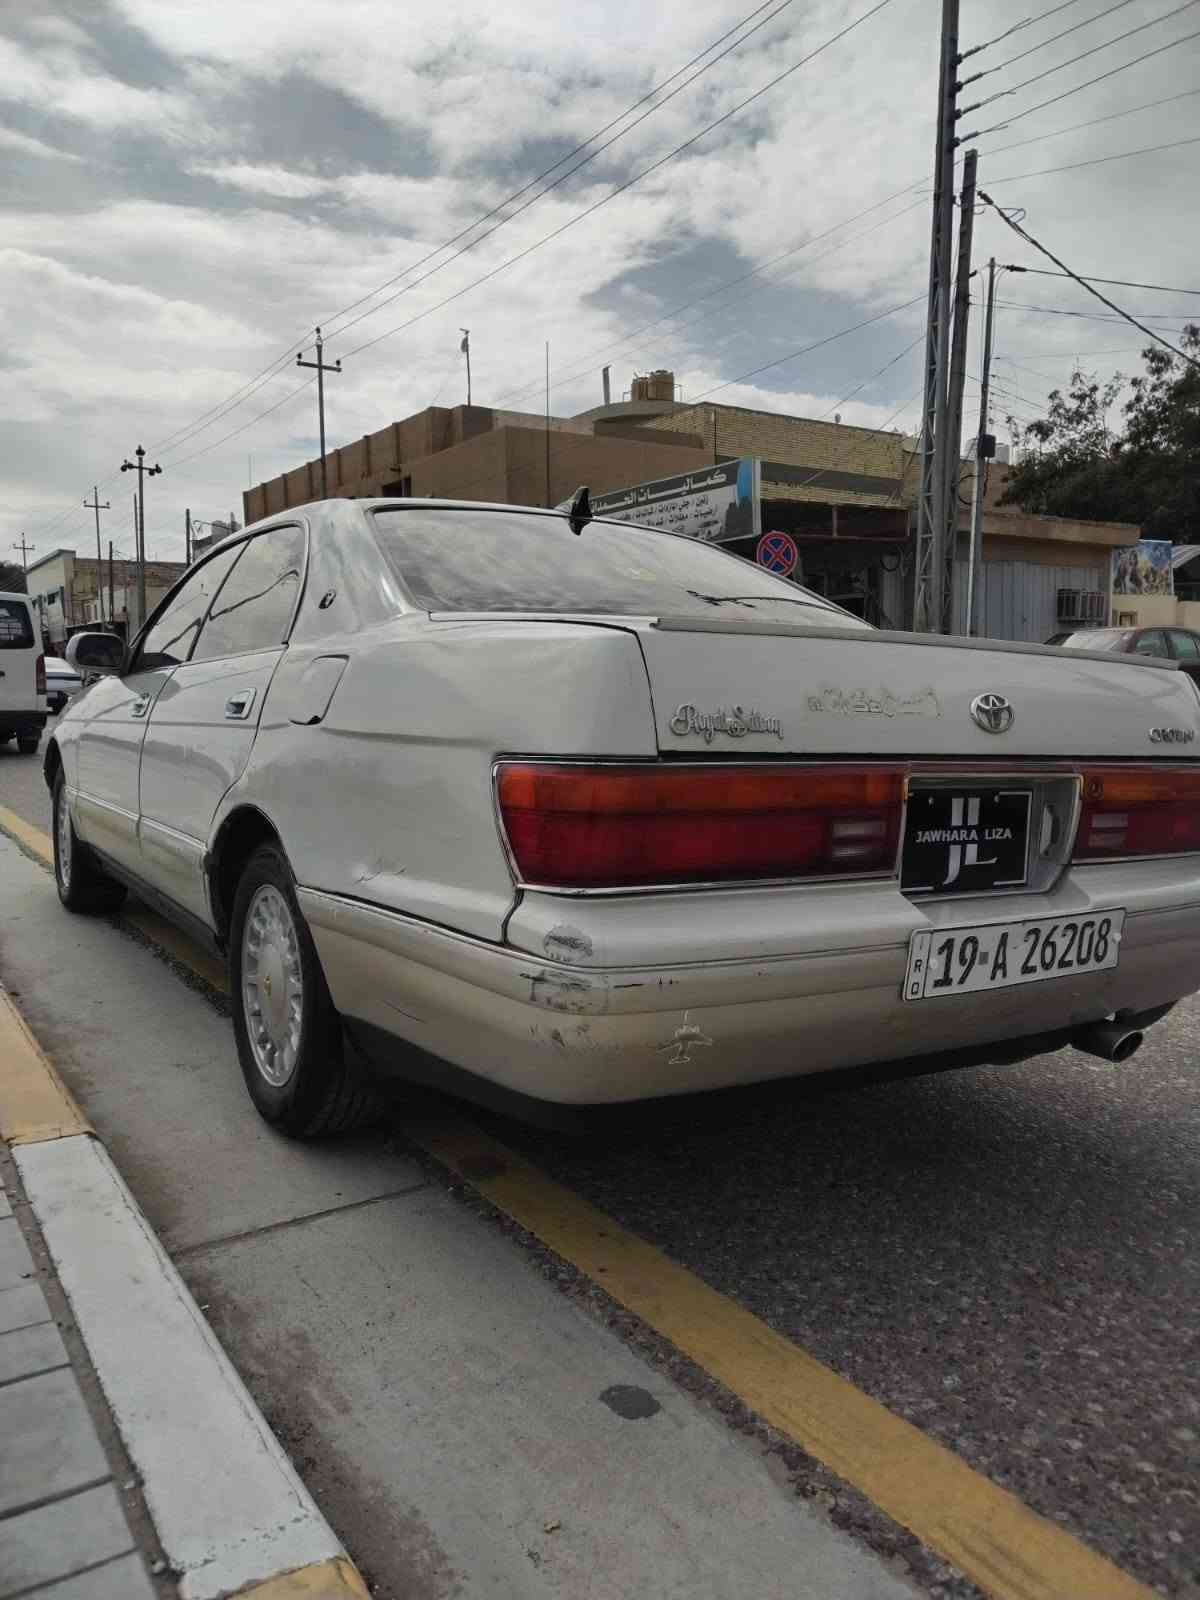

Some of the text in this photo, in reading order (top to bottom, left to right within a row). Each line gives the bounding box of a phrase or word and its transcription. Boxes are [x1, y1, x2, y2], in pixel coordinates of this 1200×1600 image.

[916, 827, 1012, 844] JAWHARA LIZA
[932, 918, 1112, 988] 19 A 26208
